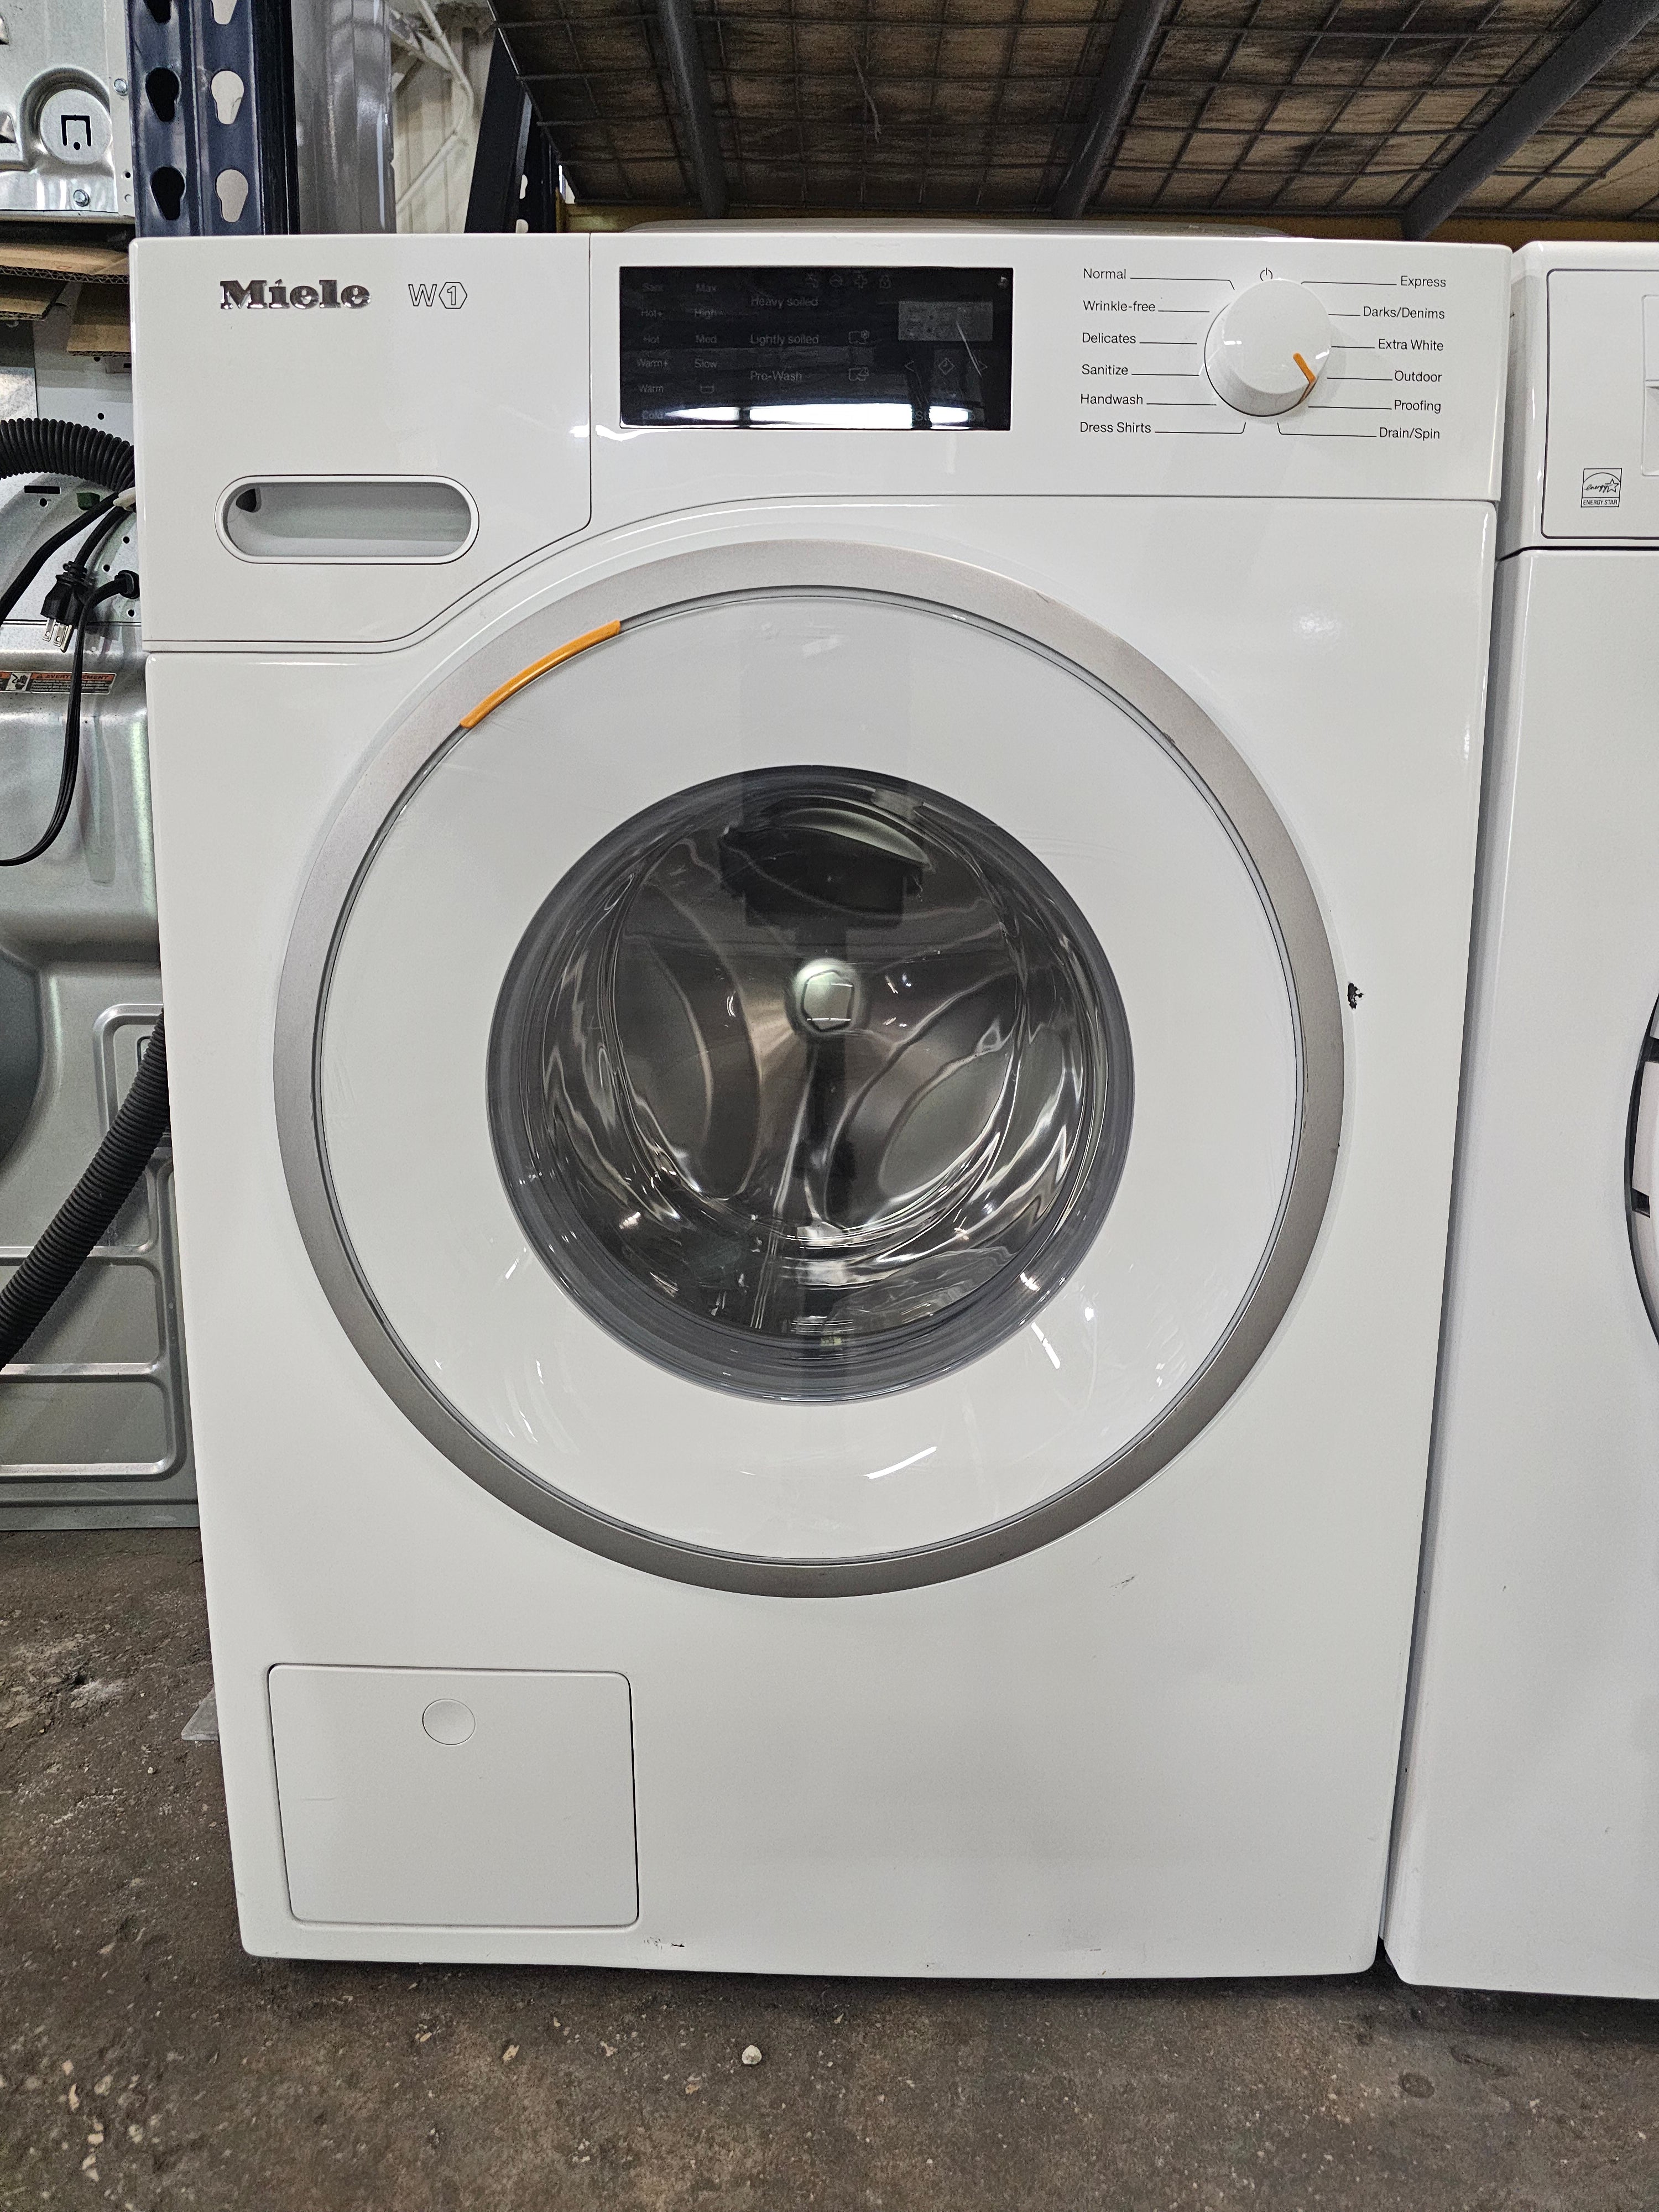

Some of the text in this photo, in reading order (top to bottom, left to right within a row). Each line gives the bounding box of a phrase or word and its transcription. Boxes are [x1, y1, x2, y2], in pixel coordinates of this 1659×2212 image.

[1083, 268, 1126, 279] Normal
[1401, 275, 1446, 289] Express
[220, 278, 372, 310] Miele
[751, 295, 819, 309] Heavy soiled
[1083, 300, 1156, 312] Wrinkle-free
[1363, 306, 1445, 319] Darks/Denims
[643, 335, 660, 344] Hot
[695, 335, 717, 344] Med
[750, 334, 819, 347] Lightly soiled
[1082, 332, 1136, 344] Delicates
[1378, 338, 1444, 351] Extra White
[694, 358, 717, 368] Slow
[1081, 363, 1129, 375] Sanitize
[750, 370, 802, 383] Pre-Wash
[1394, 369, 1443, 382] Outdoor
[639, 384, 664, 393] Warm
[1081, 393, 1143, 405] Handwash
[1394, 399, 1441, 414] Proofing
[1080, 421, 1151, 434] Dress Shirts
[1379, 426, 1440, 440] Drain/Spin
